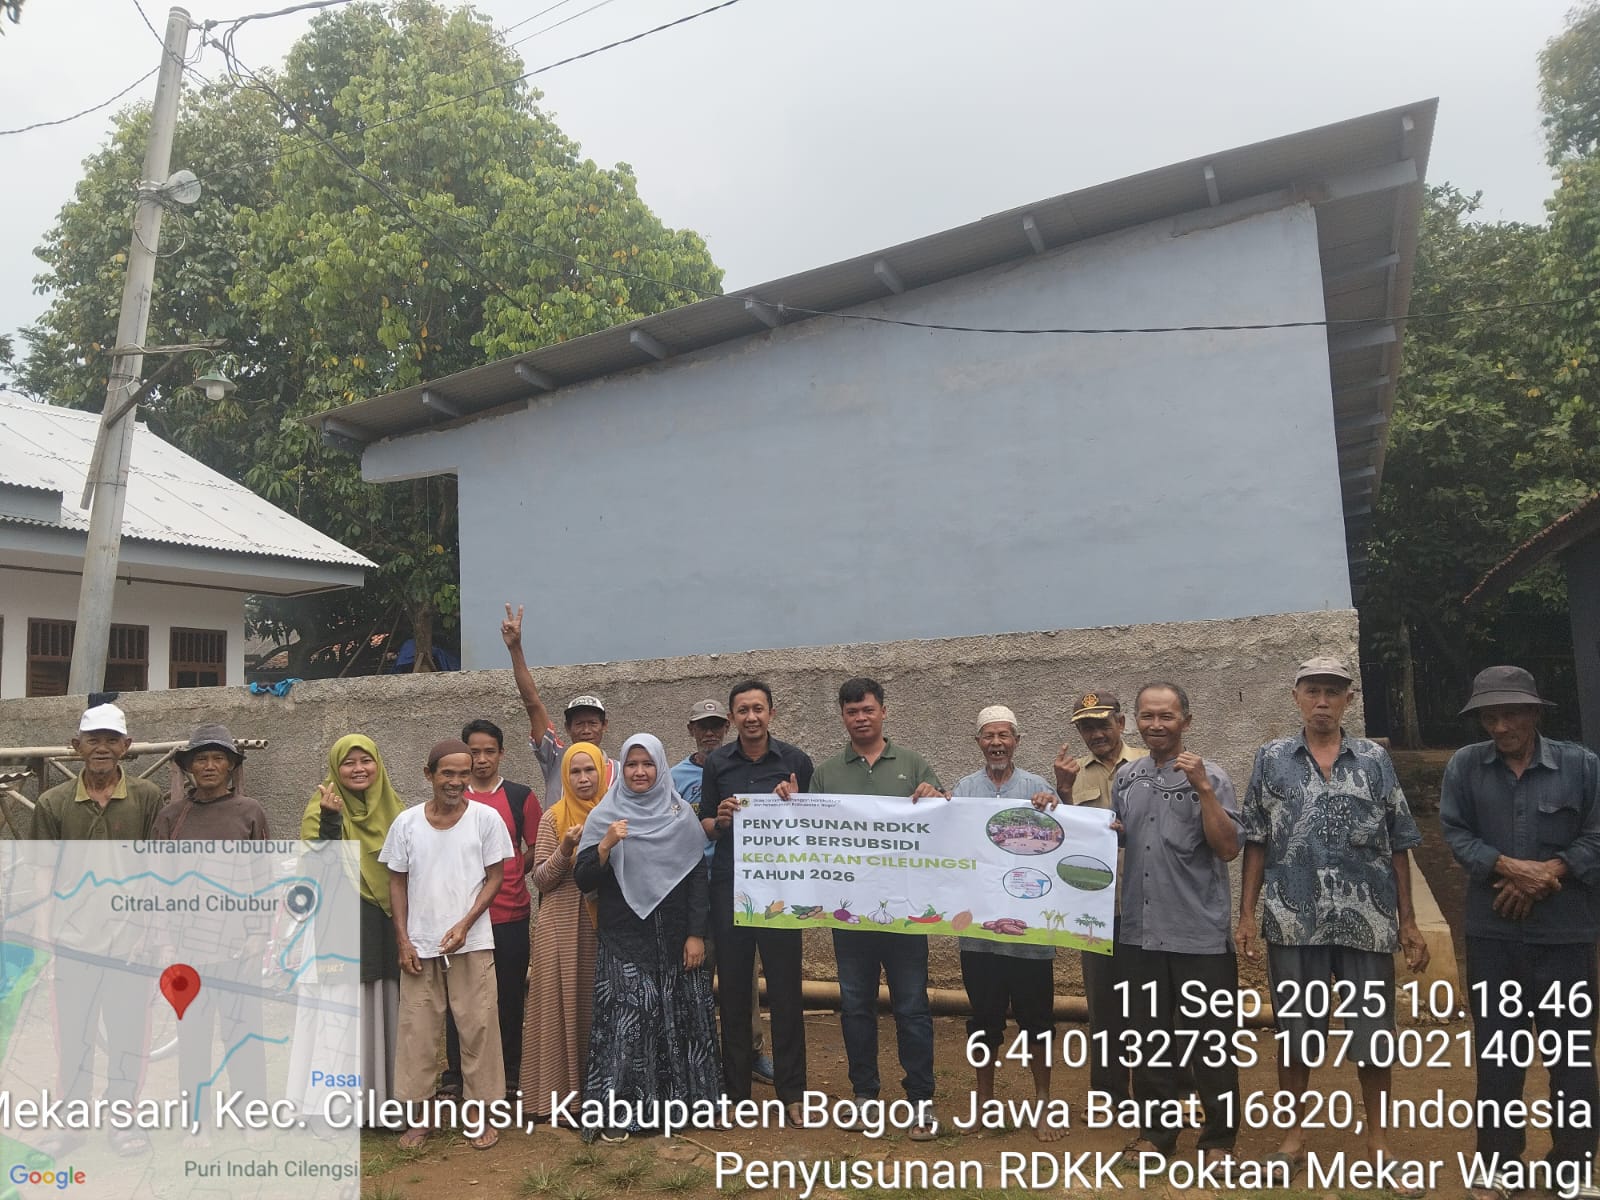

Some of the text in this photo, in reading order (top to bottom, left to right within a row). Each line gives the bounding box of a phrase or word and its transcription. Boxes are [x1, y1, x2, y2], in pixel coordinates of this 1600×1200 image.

[742, 818, 931, 834] PENYUSUNAN RDKK
[742, 835, 920, 851] PUPUK BERSUBSIDI
[742, 852, 977, 870] KECAMATAN CILEUNGSI
[742, 869, 855, 882] TAHUN 2026
